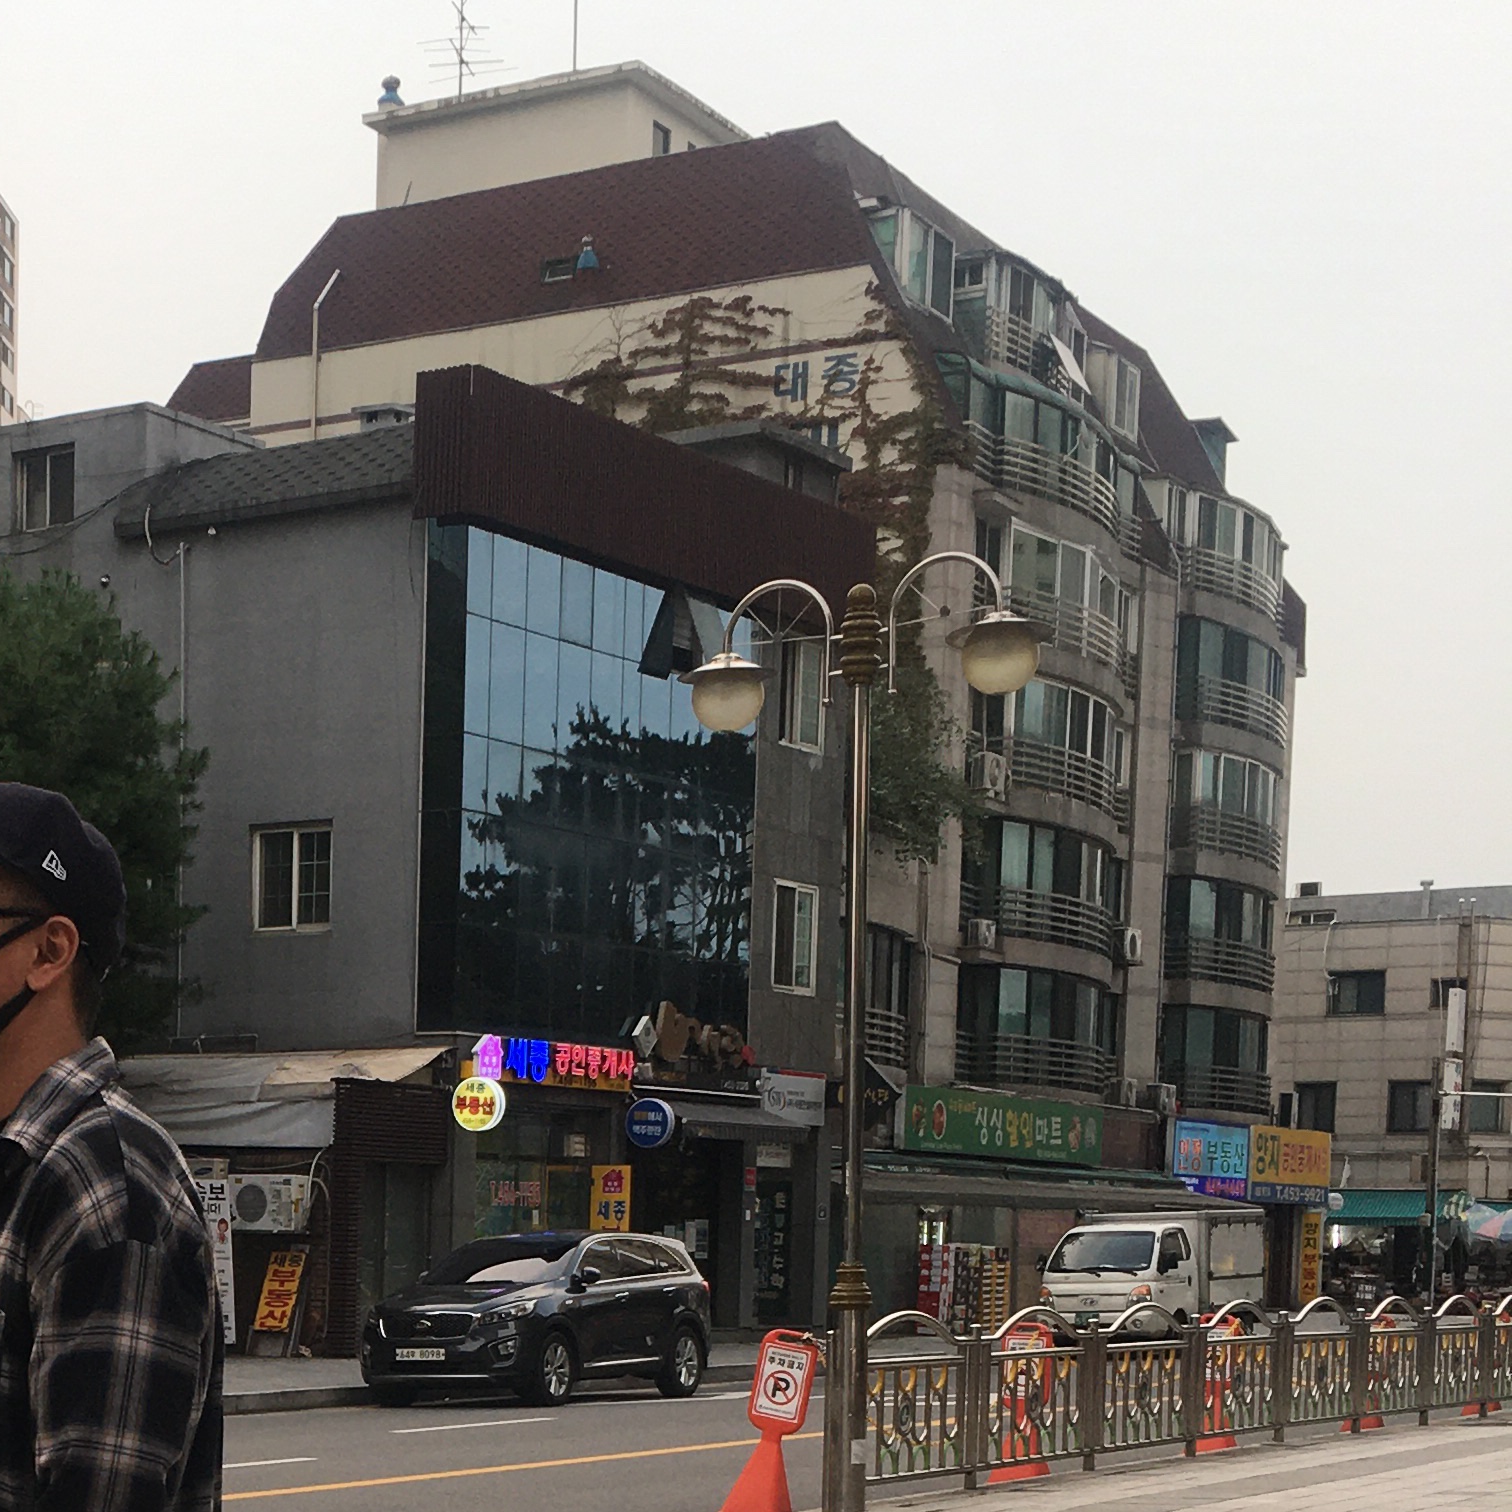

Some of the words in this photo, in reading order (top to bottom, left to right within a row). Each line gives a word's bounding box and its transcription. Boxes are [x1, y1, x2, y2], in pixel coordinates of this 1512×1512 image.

[774, 353, 859, 403] 대종
[506, 1037, 549, 1083] 세종
[555, 1042, 635, 1080] 공인중개사
[465, 1083, 486, 1094] 세종
[455, 1096, 495, 1115] 부동산
[1207, 1140, 1245, 1175] 부동산
[1256, 1133, 1281, 1176] 양지
[597, 1201, 626, 1221] 세종
[271, 1253, 304, 1268] 세종
[259, 1269, 298, 1330] 부동산
[768, 1356, 805, 1371] 주차금지
